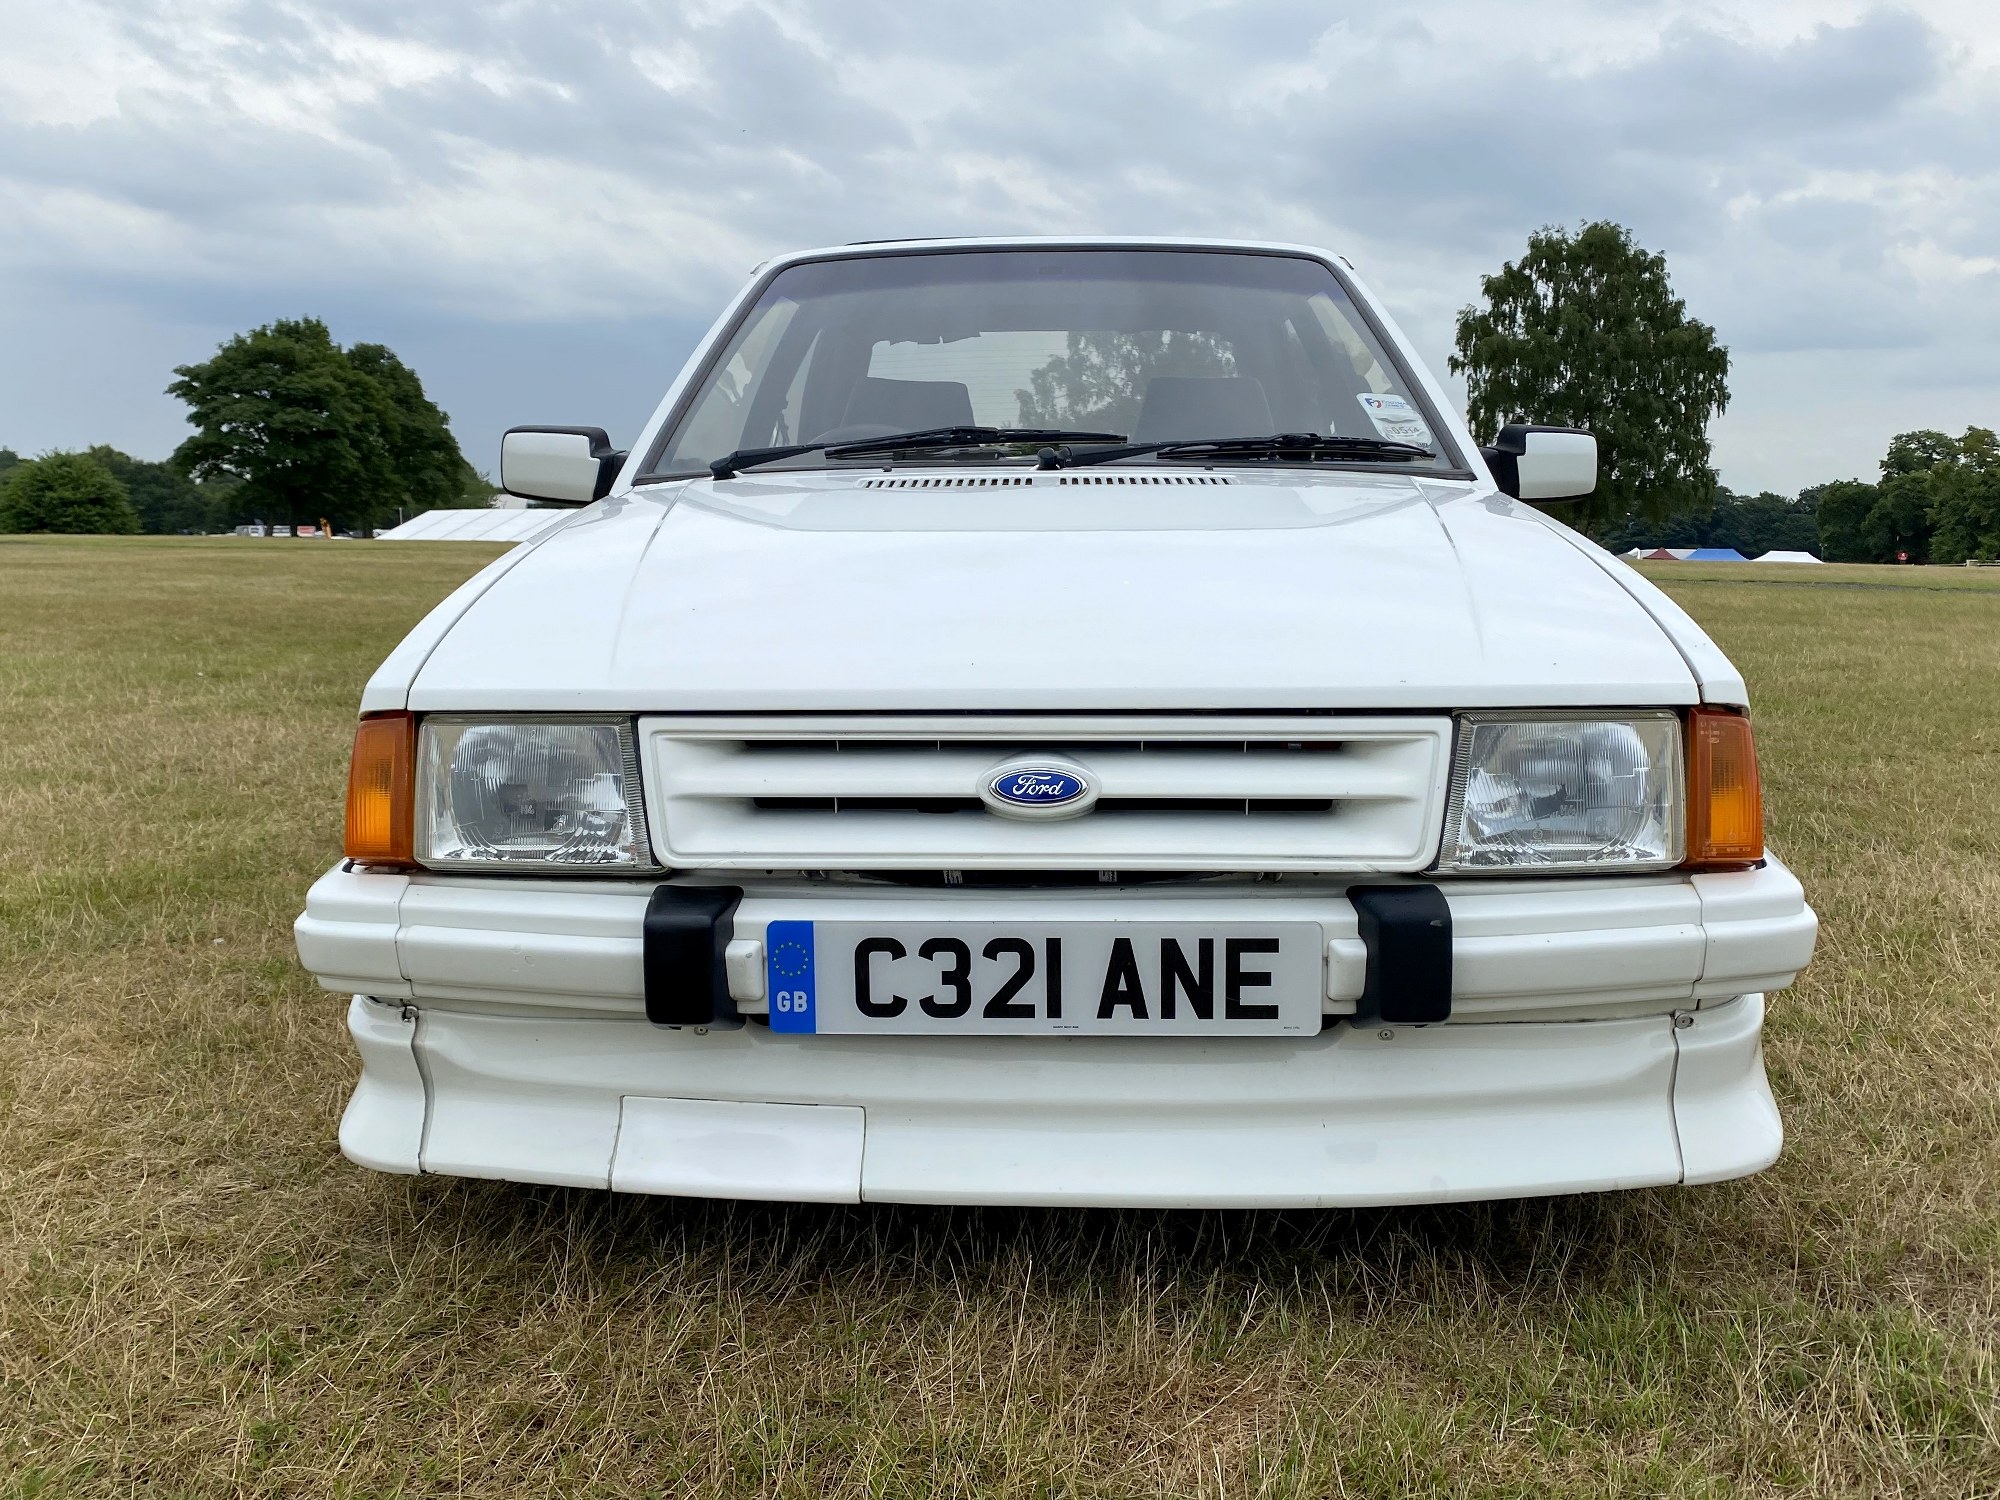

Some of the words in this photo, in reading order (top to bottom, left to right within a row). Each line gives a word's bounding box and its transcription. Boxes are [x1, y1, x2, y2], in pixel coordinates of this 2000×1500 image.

[1012, 774, 1065, 795] Ford
[854, 937, 1062, 1019] C321
[1096, 937, 1280, 1020] ANE
[776, 990, 808, 1012] GB
